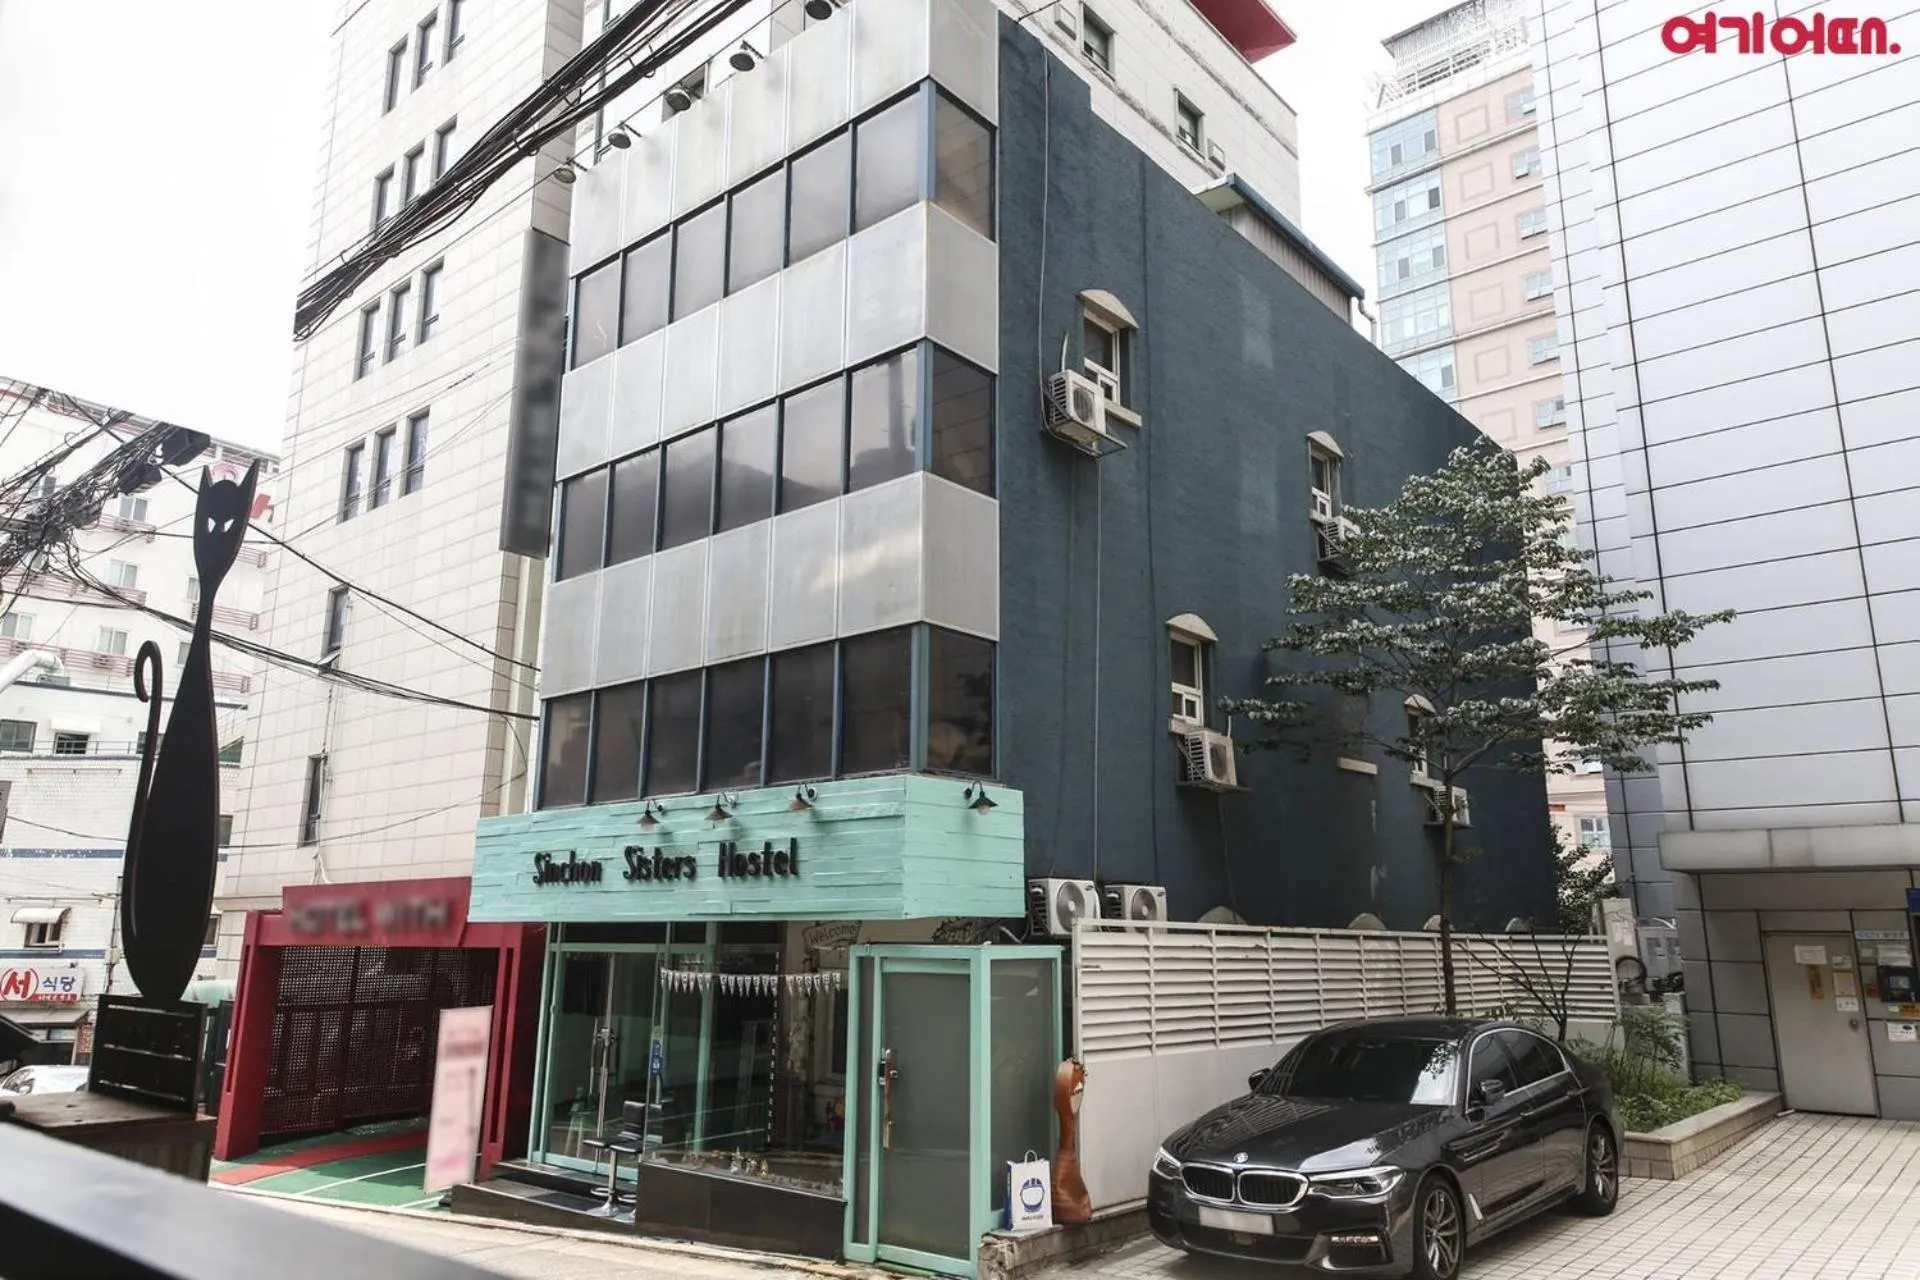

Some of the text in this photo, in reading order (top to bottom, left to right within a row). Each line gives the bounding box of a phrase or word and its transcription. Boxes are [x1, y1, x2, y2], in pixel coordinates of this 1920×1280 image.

[532, 837, 798, 884] Sinchon Sisters Hostel
[807, 921, 857, 944] Welcome
[43, 977, 76, 992] 식당
